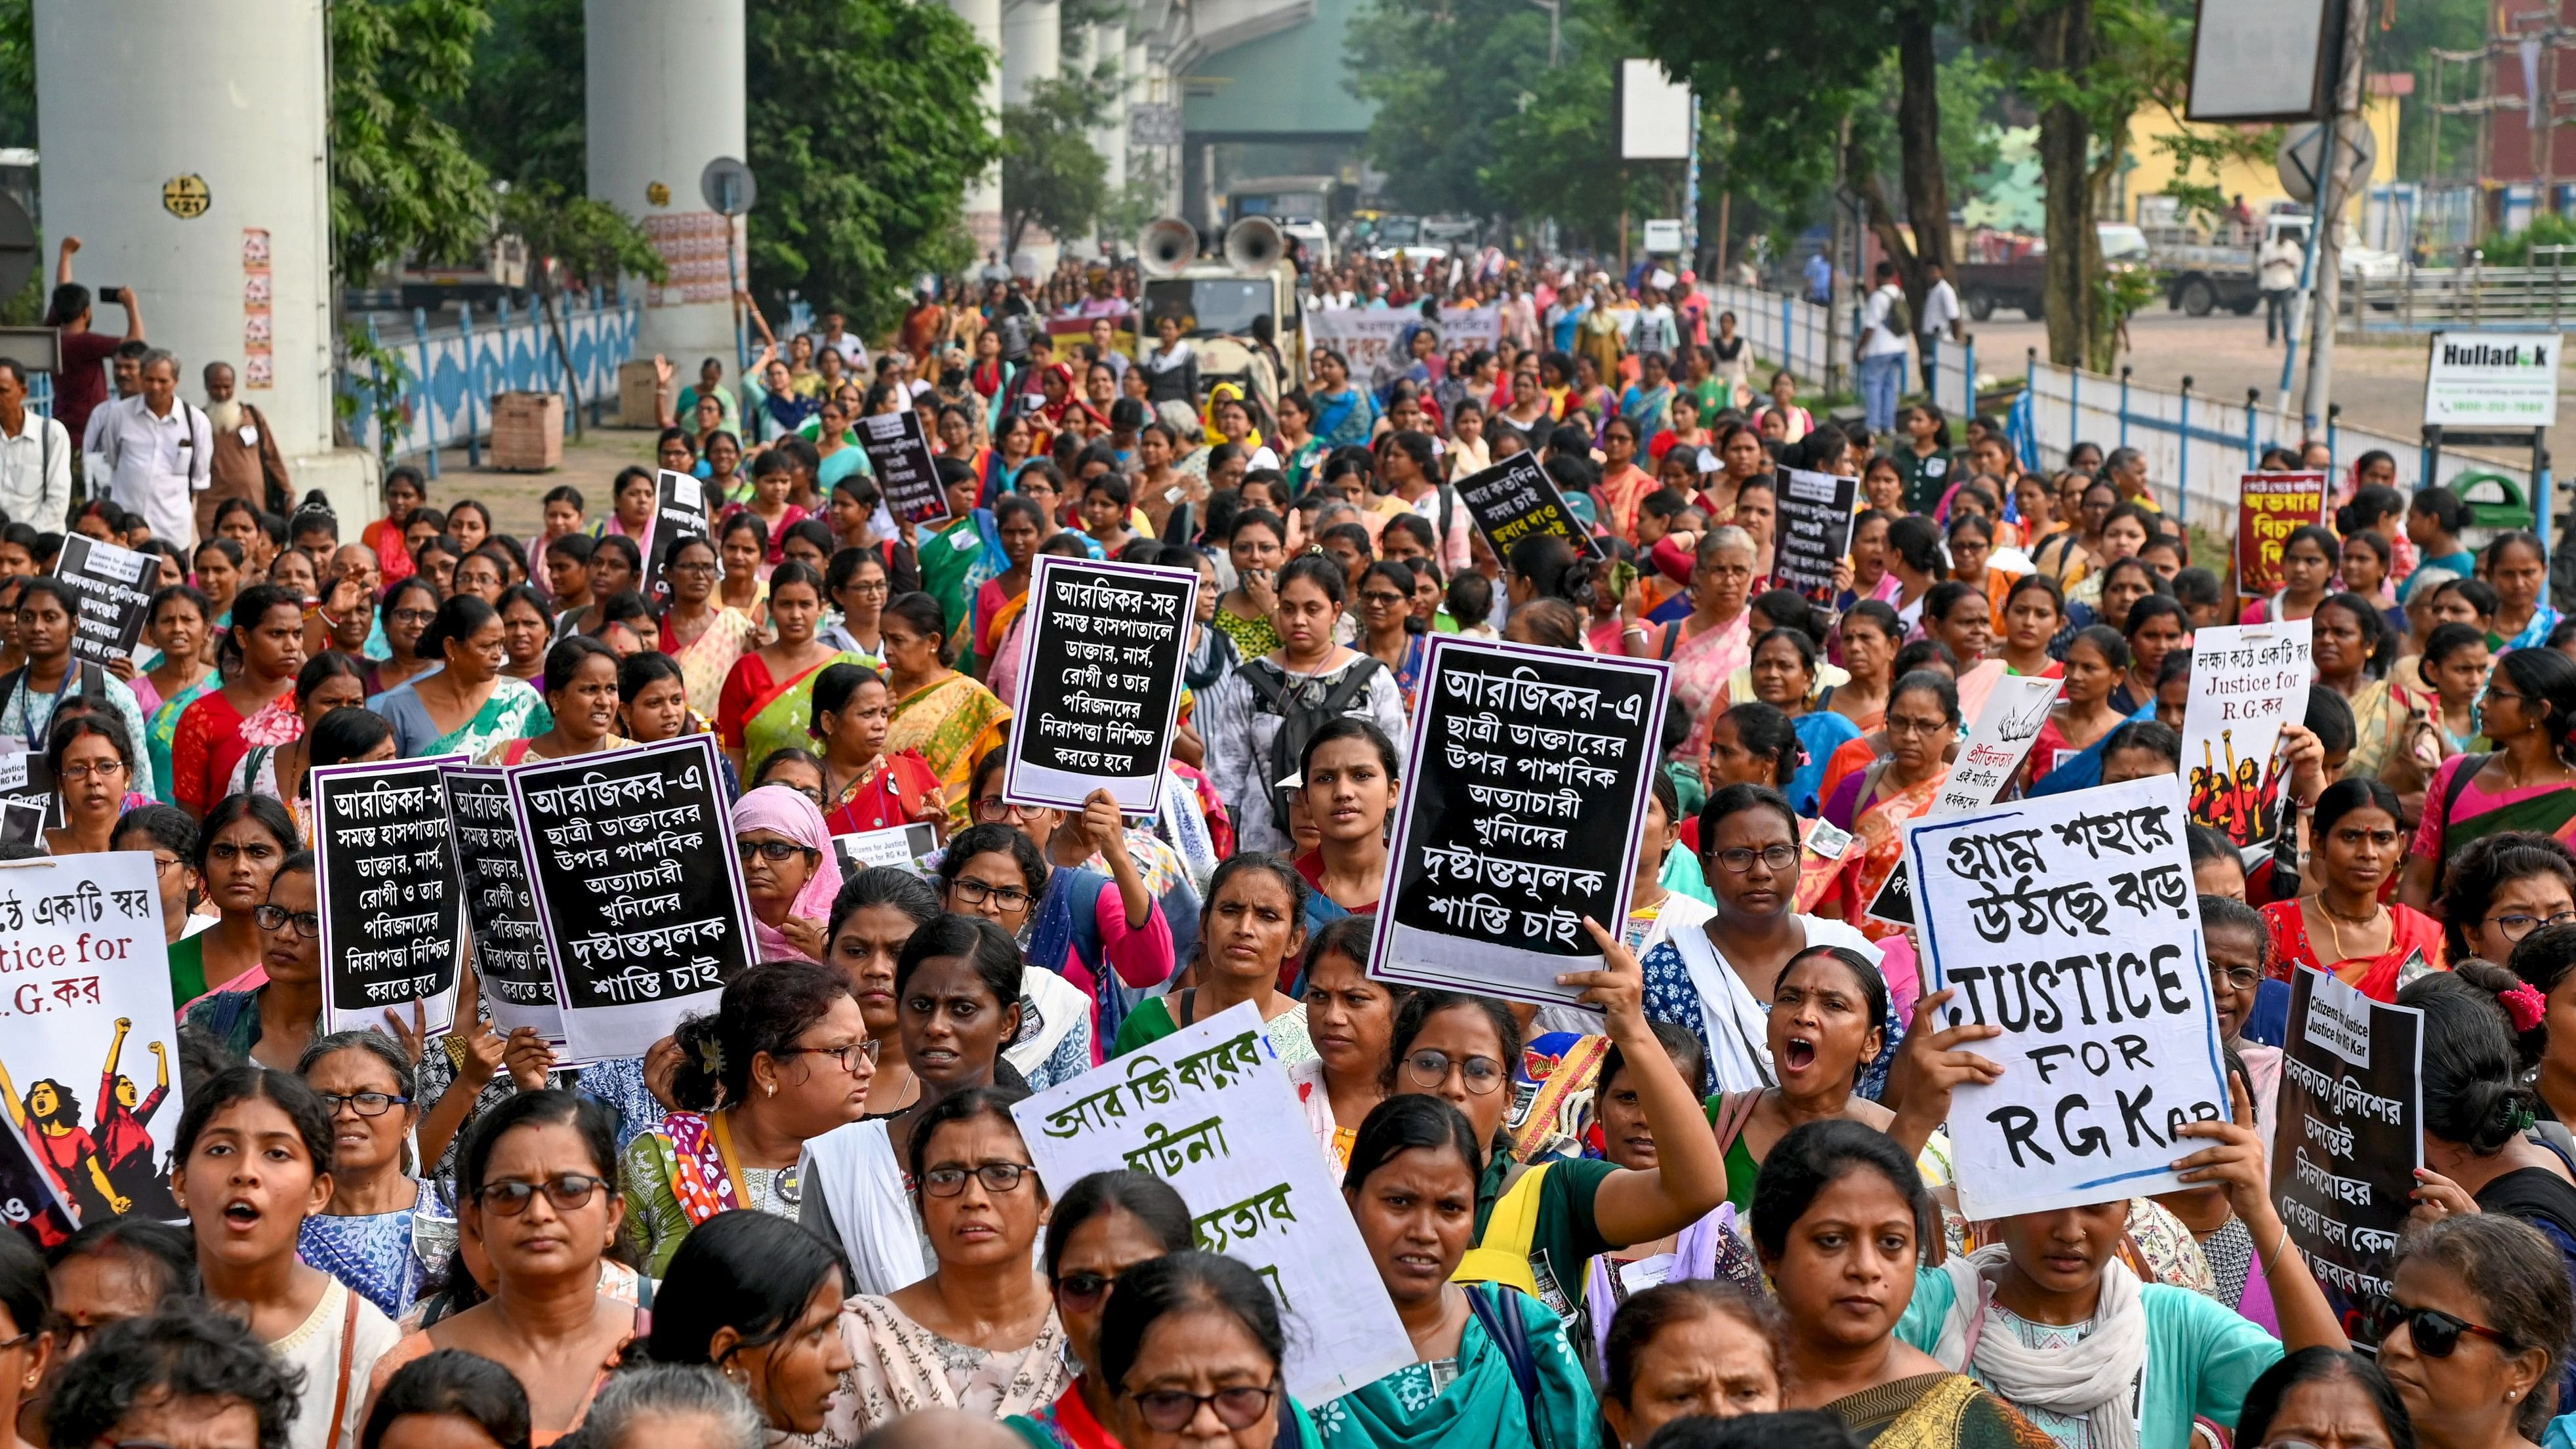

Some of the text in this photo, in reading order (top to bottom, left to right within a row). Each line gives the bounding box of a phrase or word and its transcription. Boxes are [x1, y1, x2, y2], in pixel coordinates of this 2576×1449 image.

[173, 201, 200, 212] 121
[2244, 493, 2320, 512] অভয়ার
[2253, 513, 2310, 540] বিচা
[61, 571, 150, 607] কলকাতা পুলিশের
[1055, 577, 1179, 621] আরজিকর-সহ
[1052, 611, 1174, 642] সমস্ত হাসপাতালে
[1065, 640, 1155, 668] ডাক্তার, নার্স,
[2198, 651, 2226, 672] লক্ষ্য
[2258, 638, 2293, 666] একটি
[2297, 643, 2309, 663] স্বর
[1062, 664, 1151, 693] রোগী ও তার
[1442, 665, 1643, 727] আরজিকর-এ
[2205, 671, 2299, 696] Justice for
[1062, 689, 1142, 719] পরিজনদের
[1039, 712, 1155, 746] নিরাপত্তা নিশ্চিত
[1444, 712, 1628, 759] ছাত্রী ডাক্তারের
[1053, 747, 1134, 773] করতে হবে
[1444, 740, 1619, 789] উপর পাশবিক
[1967, 743, 2014, 768] প্রীতিলতার
[0, 775, 25, 786] RG Kar
[527, 765, 703, 816] আরজিকর-এ
[1956, 767, 1999, 788] এই মাটিতে
[333, 779, 444, 820] আরজিকর-স
[1467, 784, 1583, 820] অত্যাচারী
[336, 827, 376, 849] সমস্ত
[460, 827, 489, 847] সমস্ত
[544, 804, 702, 847] ছাত্রী ডাক্তারের
[1473, 813, 1568, 850] খুনিদের
[1947, 806, 2173, 880] গ্রাম শহরে
[355, 842, 443, 878] ডাক্তার, নার্স,
[554, 830, 703, 871] উপর পাশবিক
[873, 843, 882, 851] for
[884, 839, 907, 850] Justice
[886, 851, 895, 860] RG
[476, 856, 524, 880] ডাক্তার,
[584, 858, 684, 894] অত্যাচারী
[1421, 840, 1607, 902] দৃষ্টান্তমূলক
[33, 880, 103, 926] একটি
[110, 889, 150, 919] স্বর
[359, 880, 443, 910] রোগী ও তার
[483, 882, 530, 909] রোগী ও
[599, 893, 682, 927] খুনিদের
[1967, 863, 2190, 944] উঠছে ঝড়
[363, 912, 439, 939] পরিজনদের
[1427, 893, 1583, 950] শাস্তি চাই
[0, 933, 133, 973] tice for
[345, 936, 451, 975] নিরাপত্তা নিশ্চিত
[483, 940, 531, 971] নিরাপত্তা
[568, 916, 726, 970] দৃষ্টান্তমূলক
[364, 973, 437, 1002] করতে হবে
[499, 979, 537, 1000] করতে
[590, 955, 726, 1002] শাস্তি চাই
[1947, 944, 2191, 1034] JUSTICE
[2310, 995, 2339, 1021] Citizens
[2344, 1014, 2368, 1038] Justice
[2308, 1017, 2335, 1041] Justice
[2342, 1035, 2350, 1051] RG
[2350, 1040, 2366, 1057] Kar
[2025, 1034, 2155, 1084] FOR
[1042, 1030, 1262, 1139] আর জি করের
[2285, 1053, 2403, 1126] কলকাতা পুলিশের
[2304, 1113, 2355, 1161] তদন্তেই
[785, 1178, 797, 1188] JUS
[2296, 1145, 2371, 1206] সিলমোহর
[781, 1189, 792, 1199] FOR
[2282, 1195, 2400, 1258] দেওয়া হল কেন
[2312, 1254, 2357, 1294] জবাব
